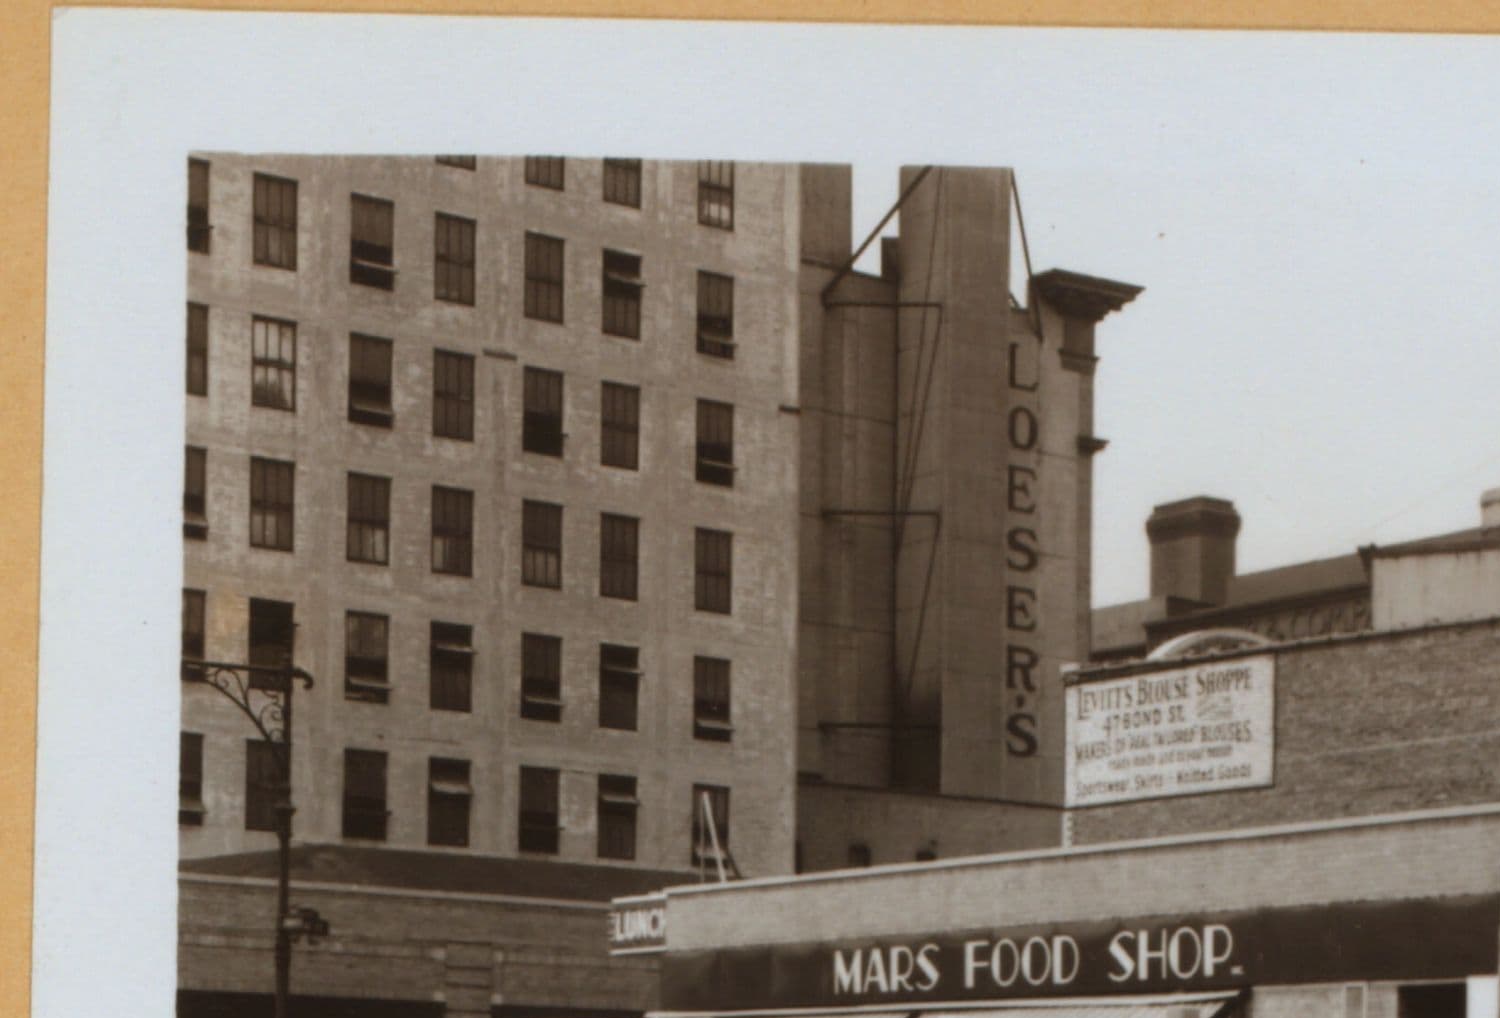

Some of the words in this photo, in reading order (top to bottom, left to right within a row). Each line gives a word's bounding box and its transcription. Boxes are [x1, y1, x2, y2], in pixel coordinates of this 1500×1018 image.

[1007, 342, 1040, 758] LOESER'S
[1137, 676, 1188, 704] BLOUSE
[1196, 667, 1252, 697] SHOPPE
[1122, 708, 1162, 730] BOND
[1201, 719, 1252, 743] BLOUSES
[833, 943, 940, 995] MARS
[964, 933, 1080, 988] FOOD
[1107, 924, 1245, 982] SHOP.
